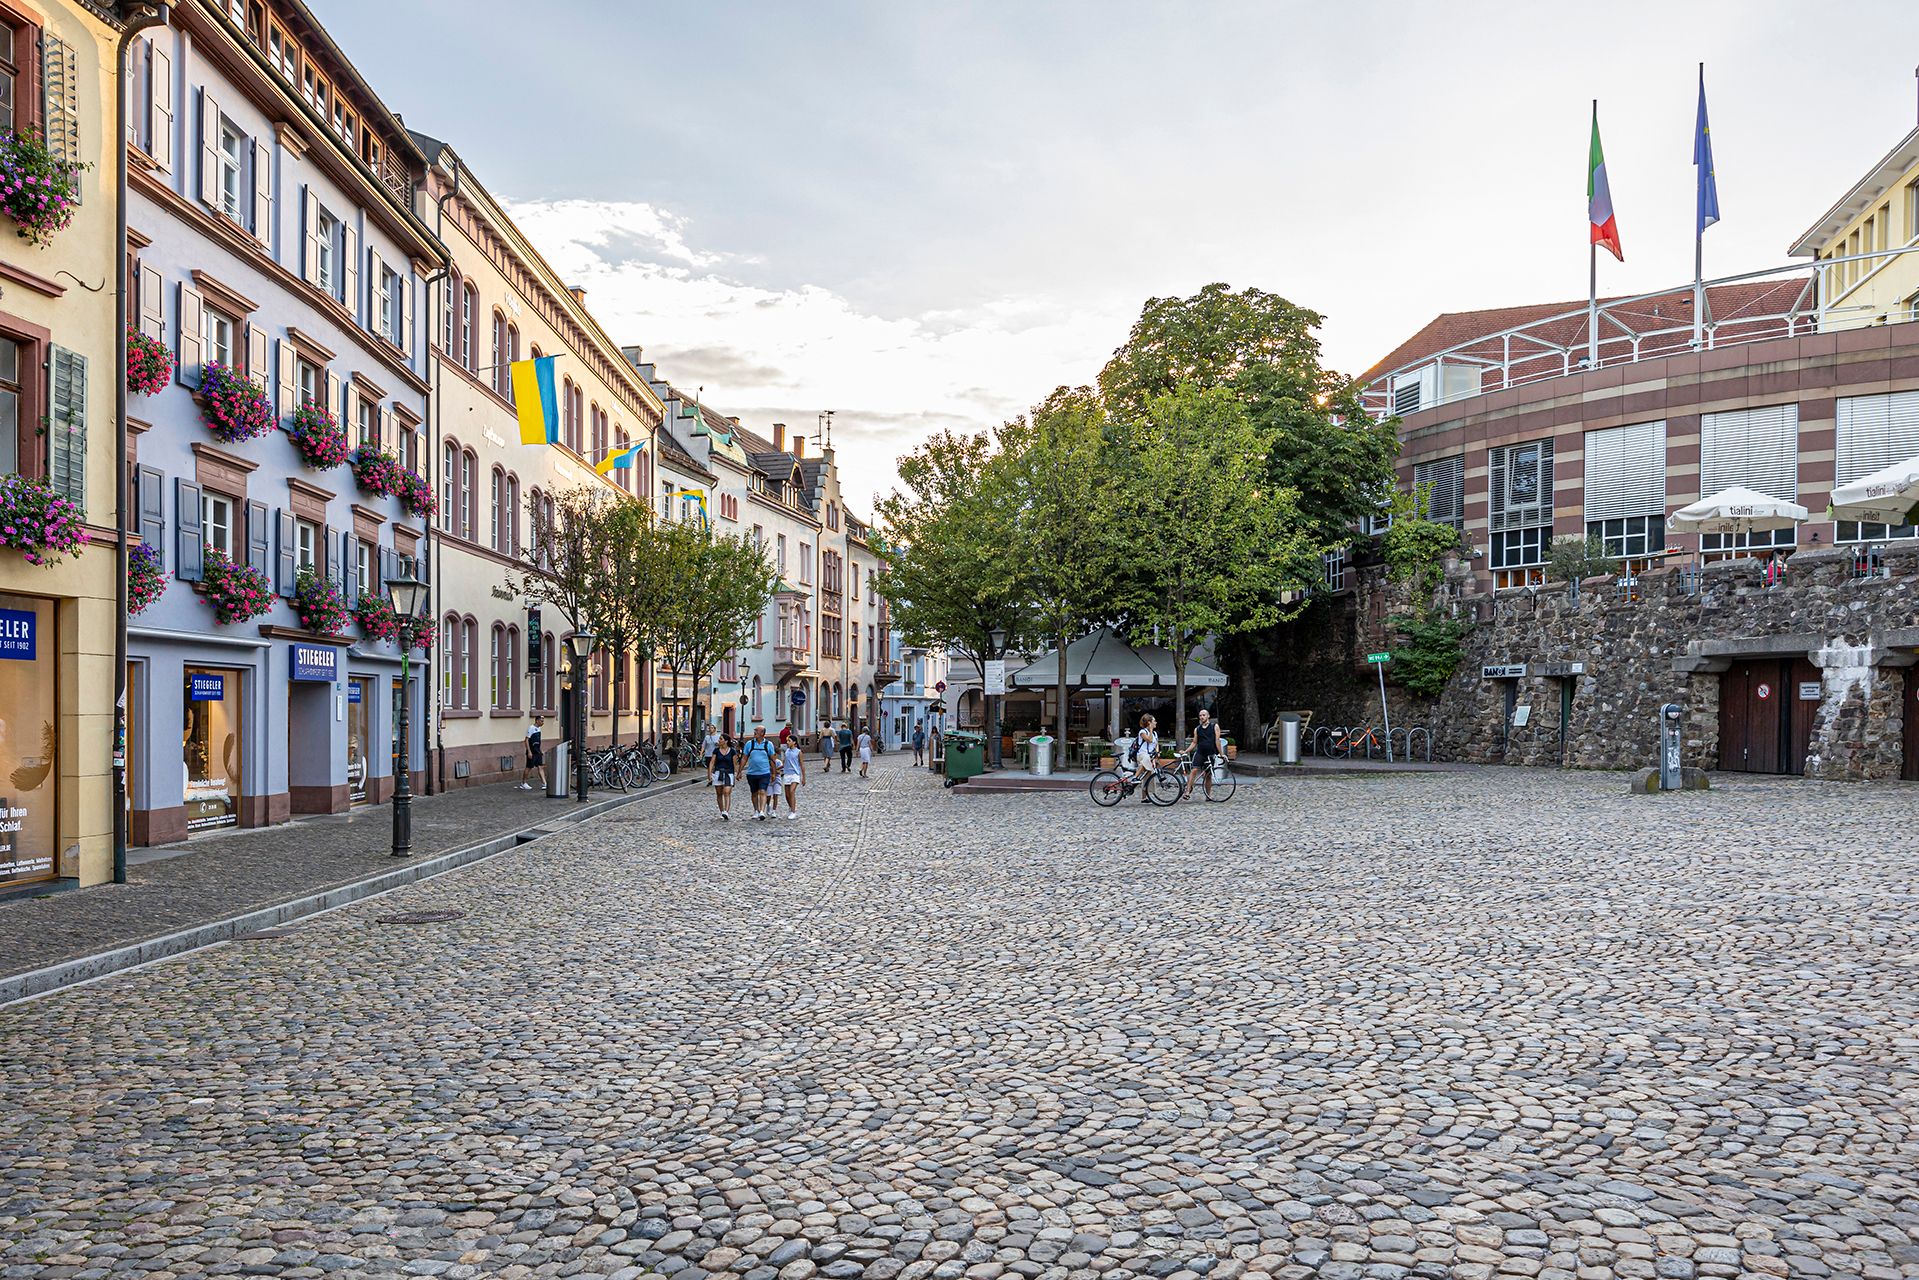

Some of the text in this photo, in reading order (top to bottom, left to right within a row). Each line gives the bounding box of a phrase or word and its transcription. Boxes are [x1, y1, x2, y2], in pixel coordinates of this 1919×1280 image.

[1866, 485, 1886, 497] tialini
[1730, 506, 1753, 515] tialini
[4, 640, 30, 650] SEIT 1902
[298, 648, 335, 667] STIEGELER
[194, 679, 222, 690] STIEGELER
[10, 806, 28, 818] Ihren
